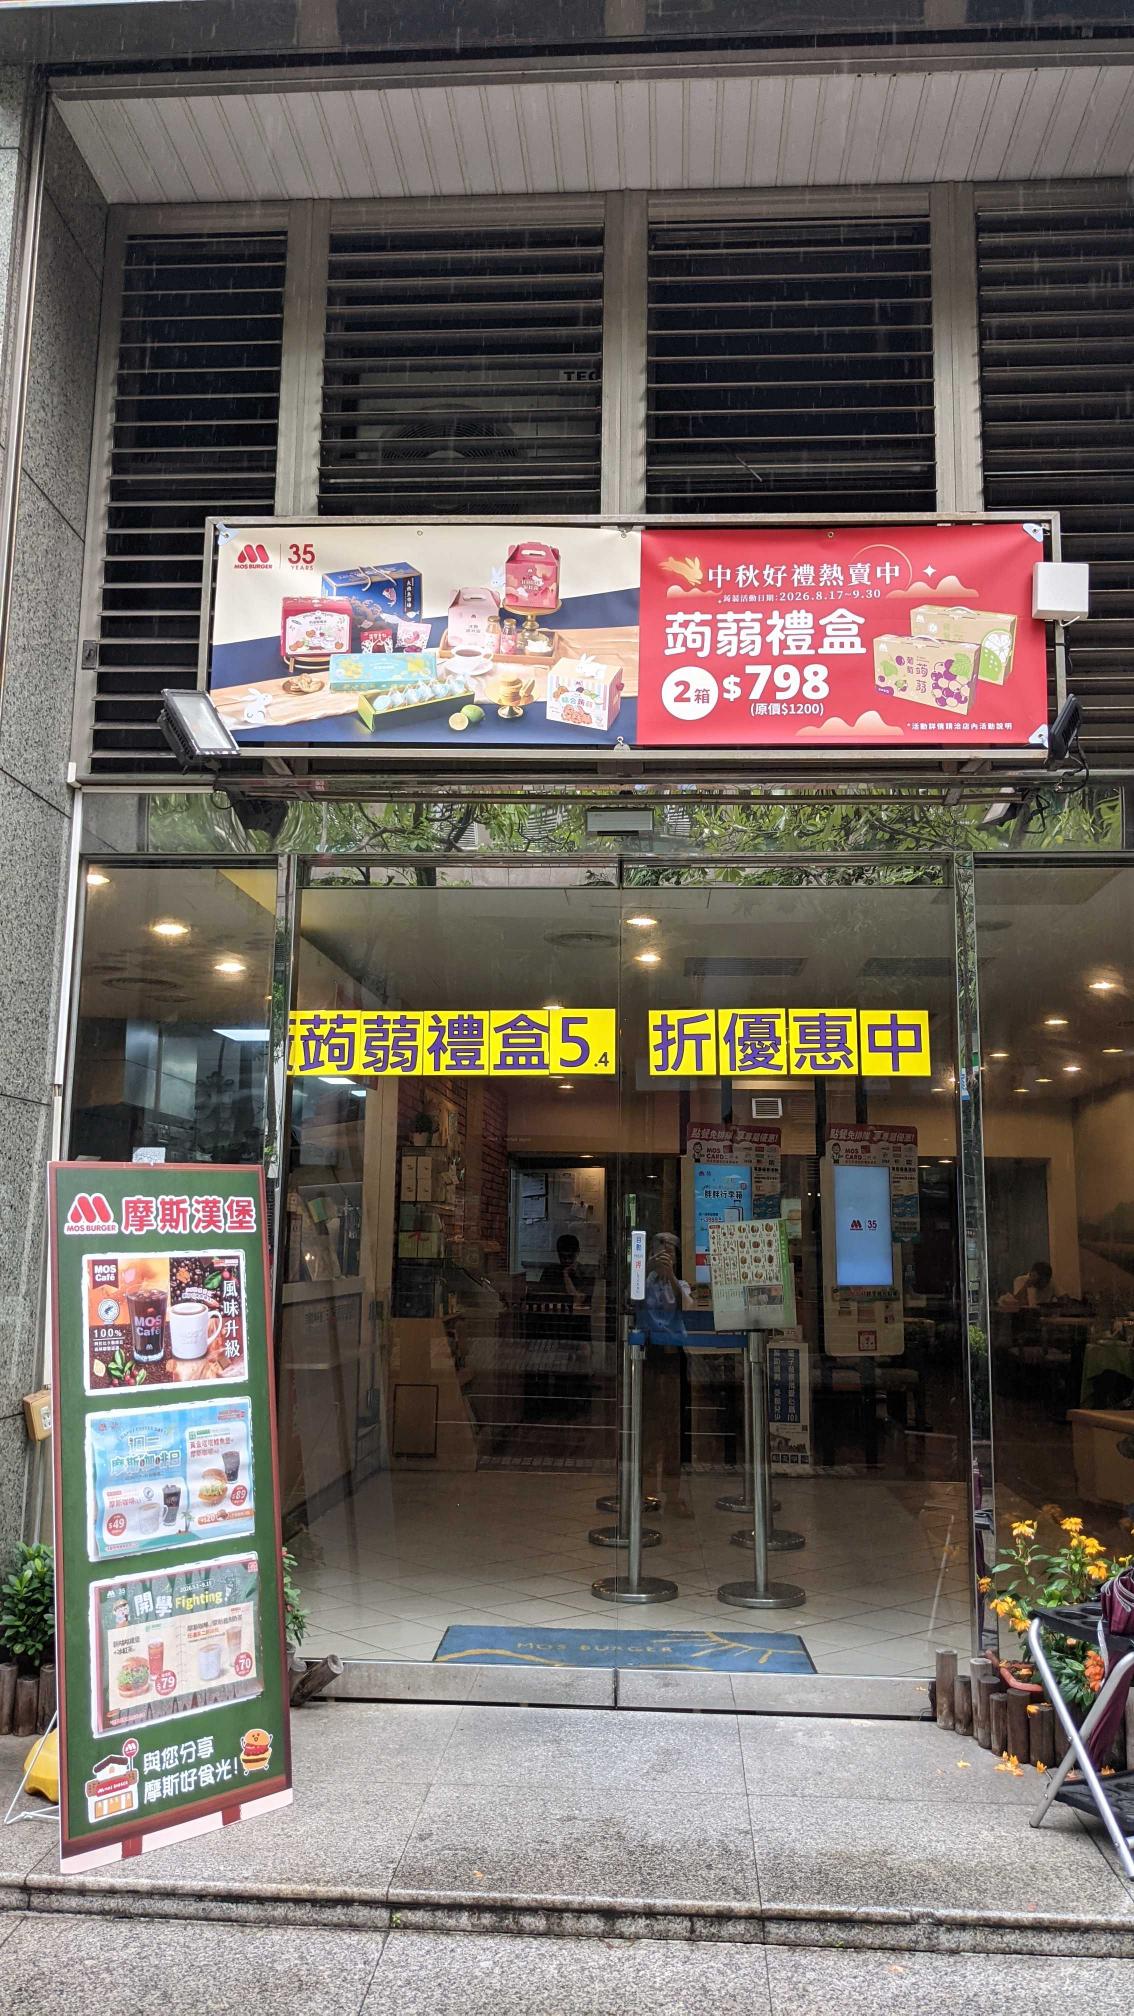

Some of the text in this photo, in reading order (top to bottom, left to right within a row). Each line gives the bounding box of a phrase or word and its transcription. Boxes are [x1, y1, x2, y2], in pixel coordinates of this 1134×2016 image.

[288, 544, 316, 564] 35
[707, 562, 902, 589] 中秋好禮熱賣中
[664, 607, 867, 658] 蒟蒻禮盒
[673, 679, 711, 705] 2箱
[722, 663, 830, 702] $798
[750, 701, 825, 717] (原價$1200)
[652, 1013, 924, 1074] 折優惠中
[124, 1198, 254, 1232] 摩斯漢堡
[867, 1220, 878, 1229] 35
[94, 1264, 117, 1274] MOS
[95, 1273, 116, 1282] Café
[134, 1315, 162, 1328] MOS
[136, 1327, 161, 1337] Café
[222, 1280, 241, 1358] 風味升級
[134, 1591, 173, 1617] 開學
[156, 1676, 175, 1690] $79
[143, 1736, 214, 1775] 與您分享
[143, 1757, 239, 1804] 摩斯好食光!
